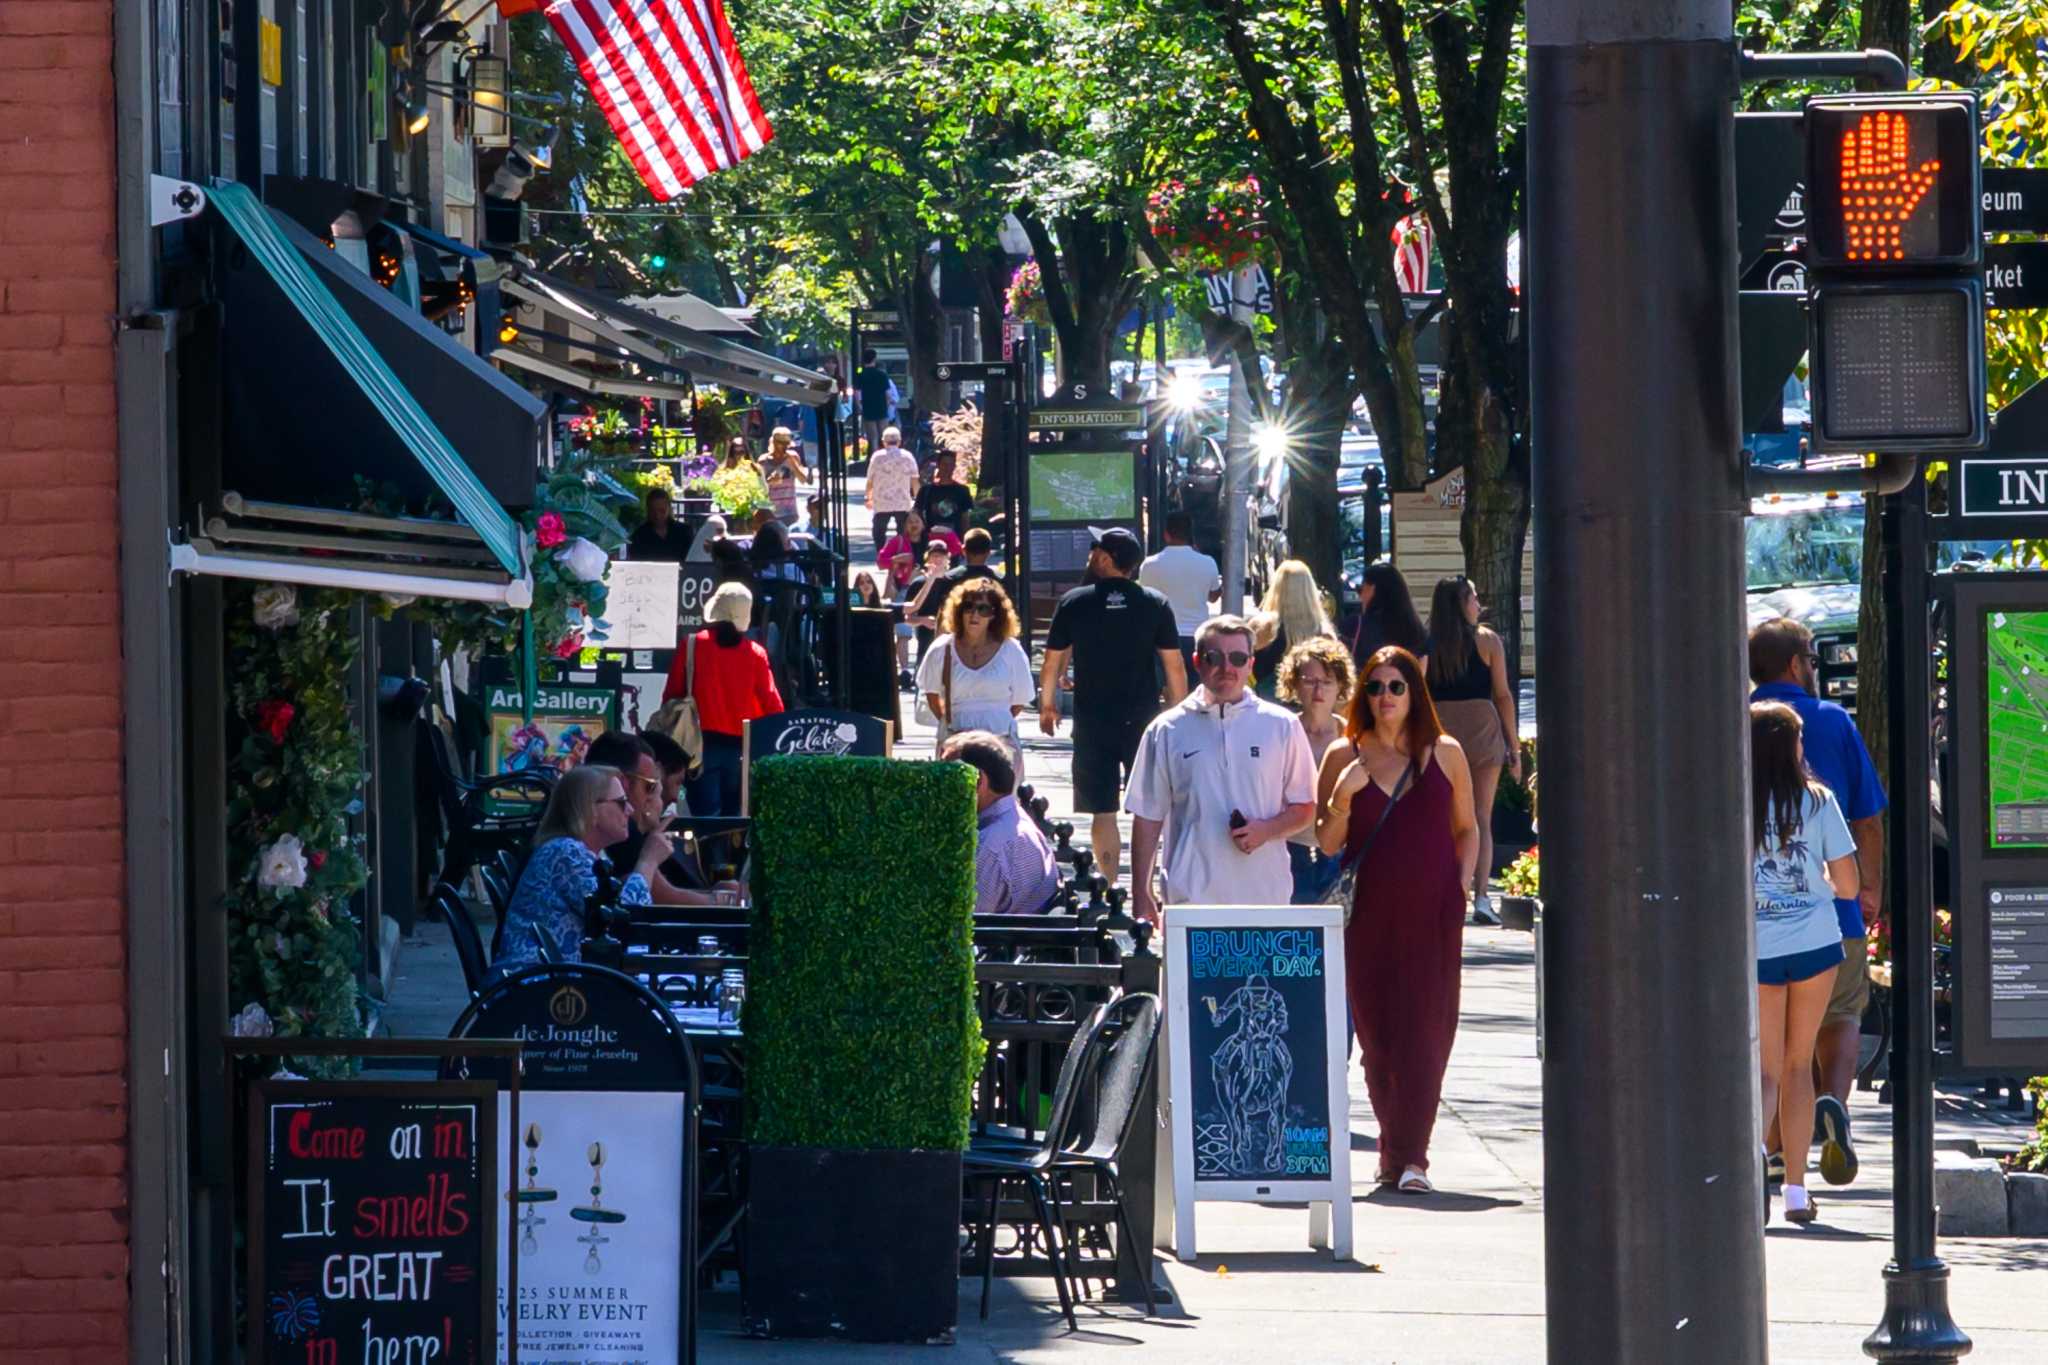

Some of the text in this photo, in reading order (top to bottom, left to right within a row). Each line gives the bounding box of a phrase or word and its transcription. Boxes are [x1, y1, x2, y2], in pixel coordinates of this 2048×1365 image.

[1039, 414, 1124, 425] INFORMATION
[1998, 470, 2048, 505] IN
[533, 689, 610, 714] Gallery
[775, 725, 837, 755] Gelato
[1250, 746, 1260, 758] S
[1191, 930, 1322, 957] BRUNCH.
[1273, 956, 1321, 977] DAY.
[591, 1048, 639, 1063] Jewelry
[288, 1109, 367, 1161] Come
[390, 1123, 422, 1160] on
[1286, 1155, 1330, 1174] 3PM
[282, 1170, 471, 1239] It smells
[323, 1251, 443, 1301] GREAT
[548, 1287, 629, 1301] SUMMER
[578, 1303, 648, 1321] EVENT
[517, 1330, 642, 1340] OLLECTION GIVEAWAYS
[546, 1343, 591, 1352] JEWELRY
[594, 1343, 645, 1352] CLEANING
